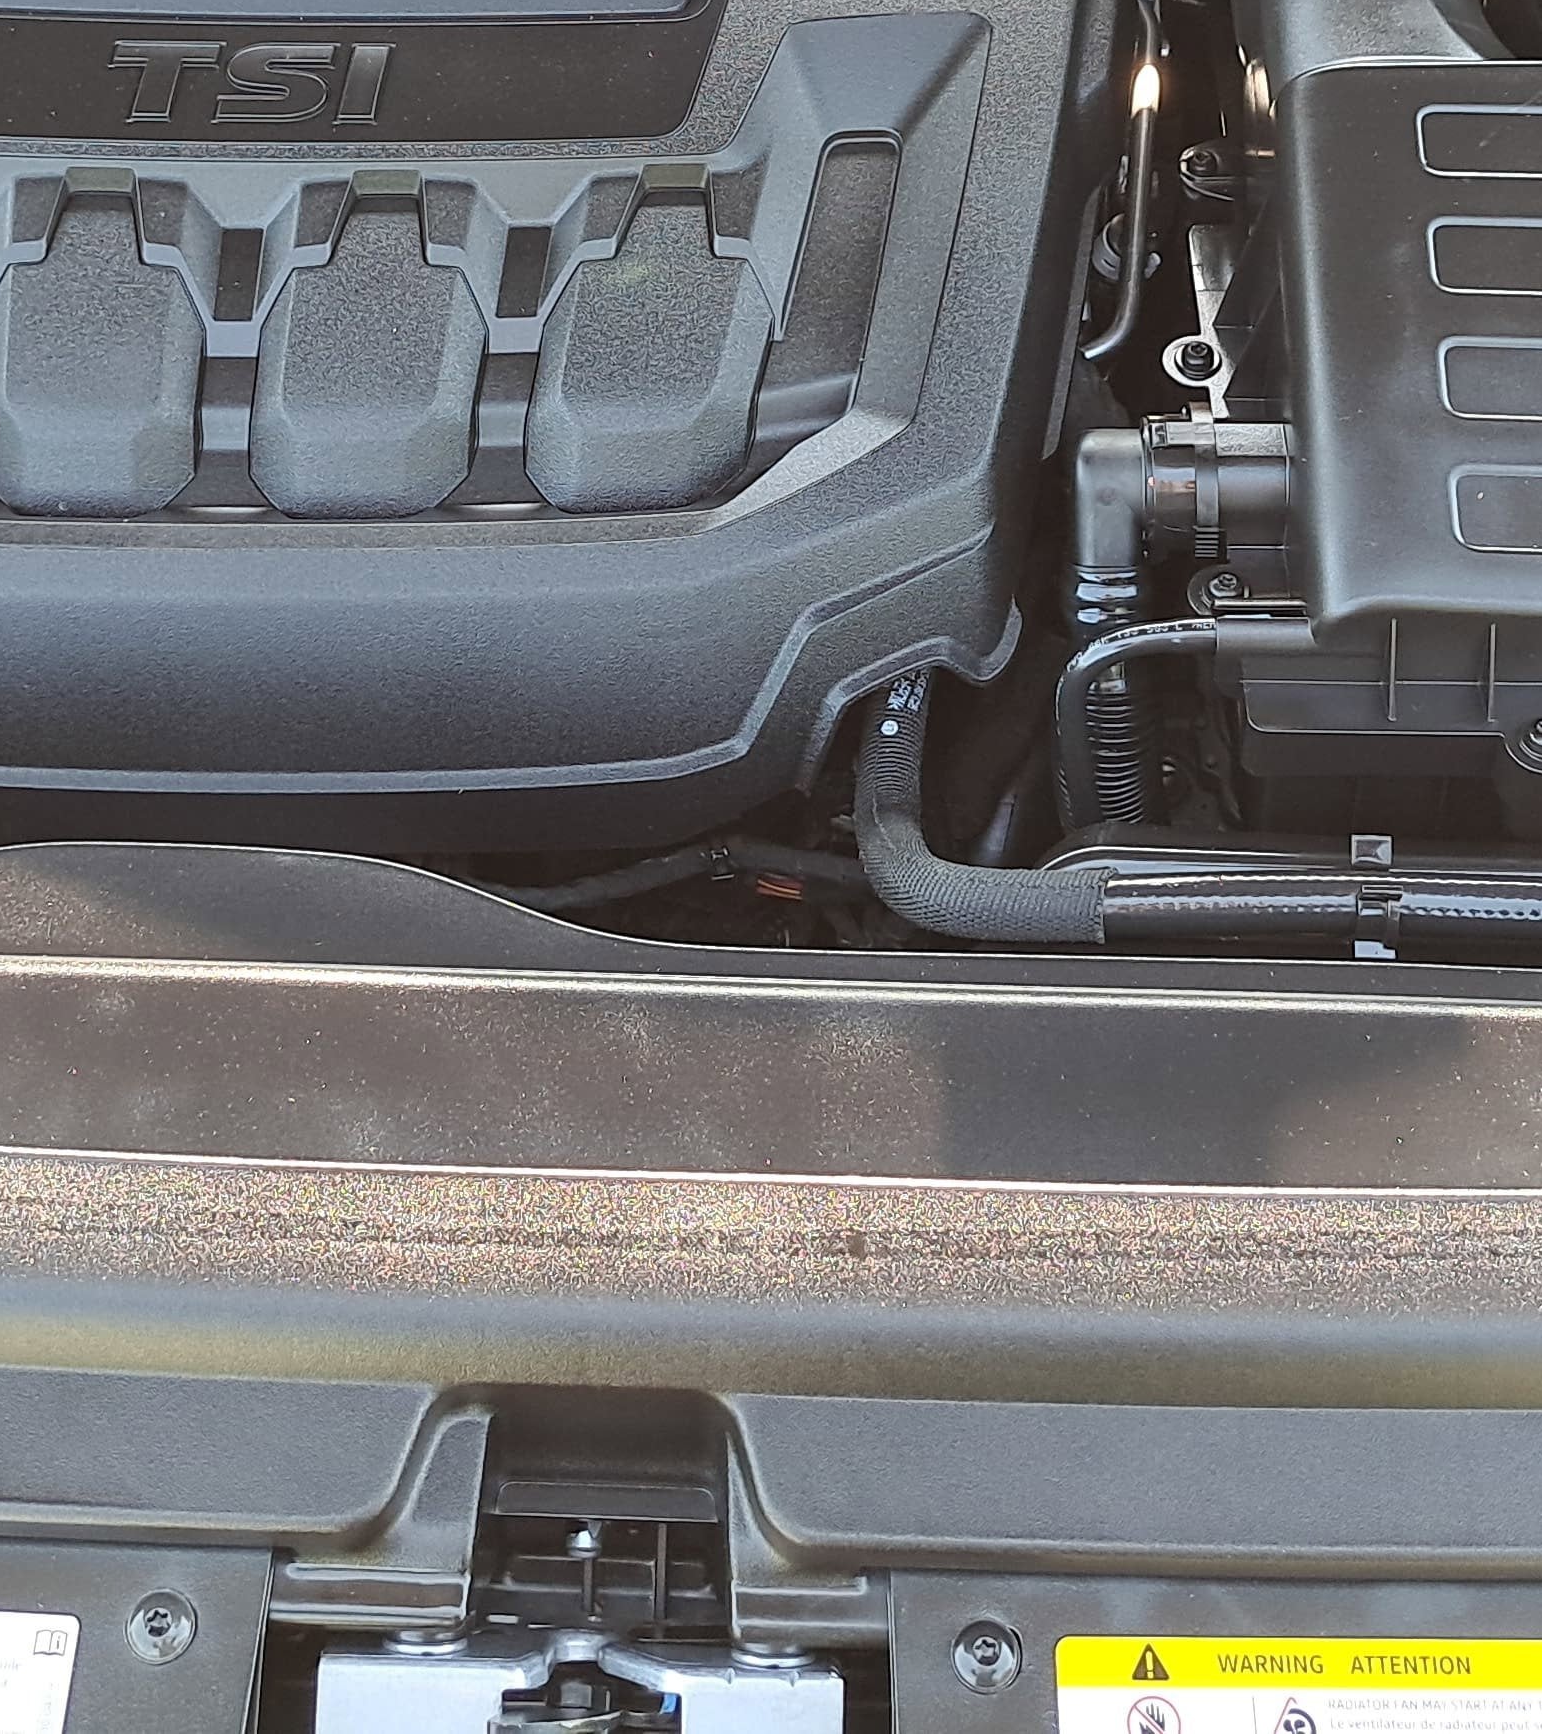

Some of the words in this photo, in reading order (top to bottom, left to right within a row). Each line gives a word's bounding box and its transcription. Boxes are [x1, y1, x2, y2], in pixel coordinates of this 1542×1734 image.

[108, 39, 397, 127] TSI
[1217, 1653, 1324, 1675] WARNING
[1350, 1654, 1472, 1675] ATTENTION
[1327, 1698, 1390, 1711] RADIATOR
[1330, 1718, 1344, 1731] Le
[1347, 1718, 1417, 1731] ventilateur
[1420, 1719, 1436, 1731] de
[1439, 1719, 1497, 1732] radiateur
[1500, 1720, 1531, 1734] peut
